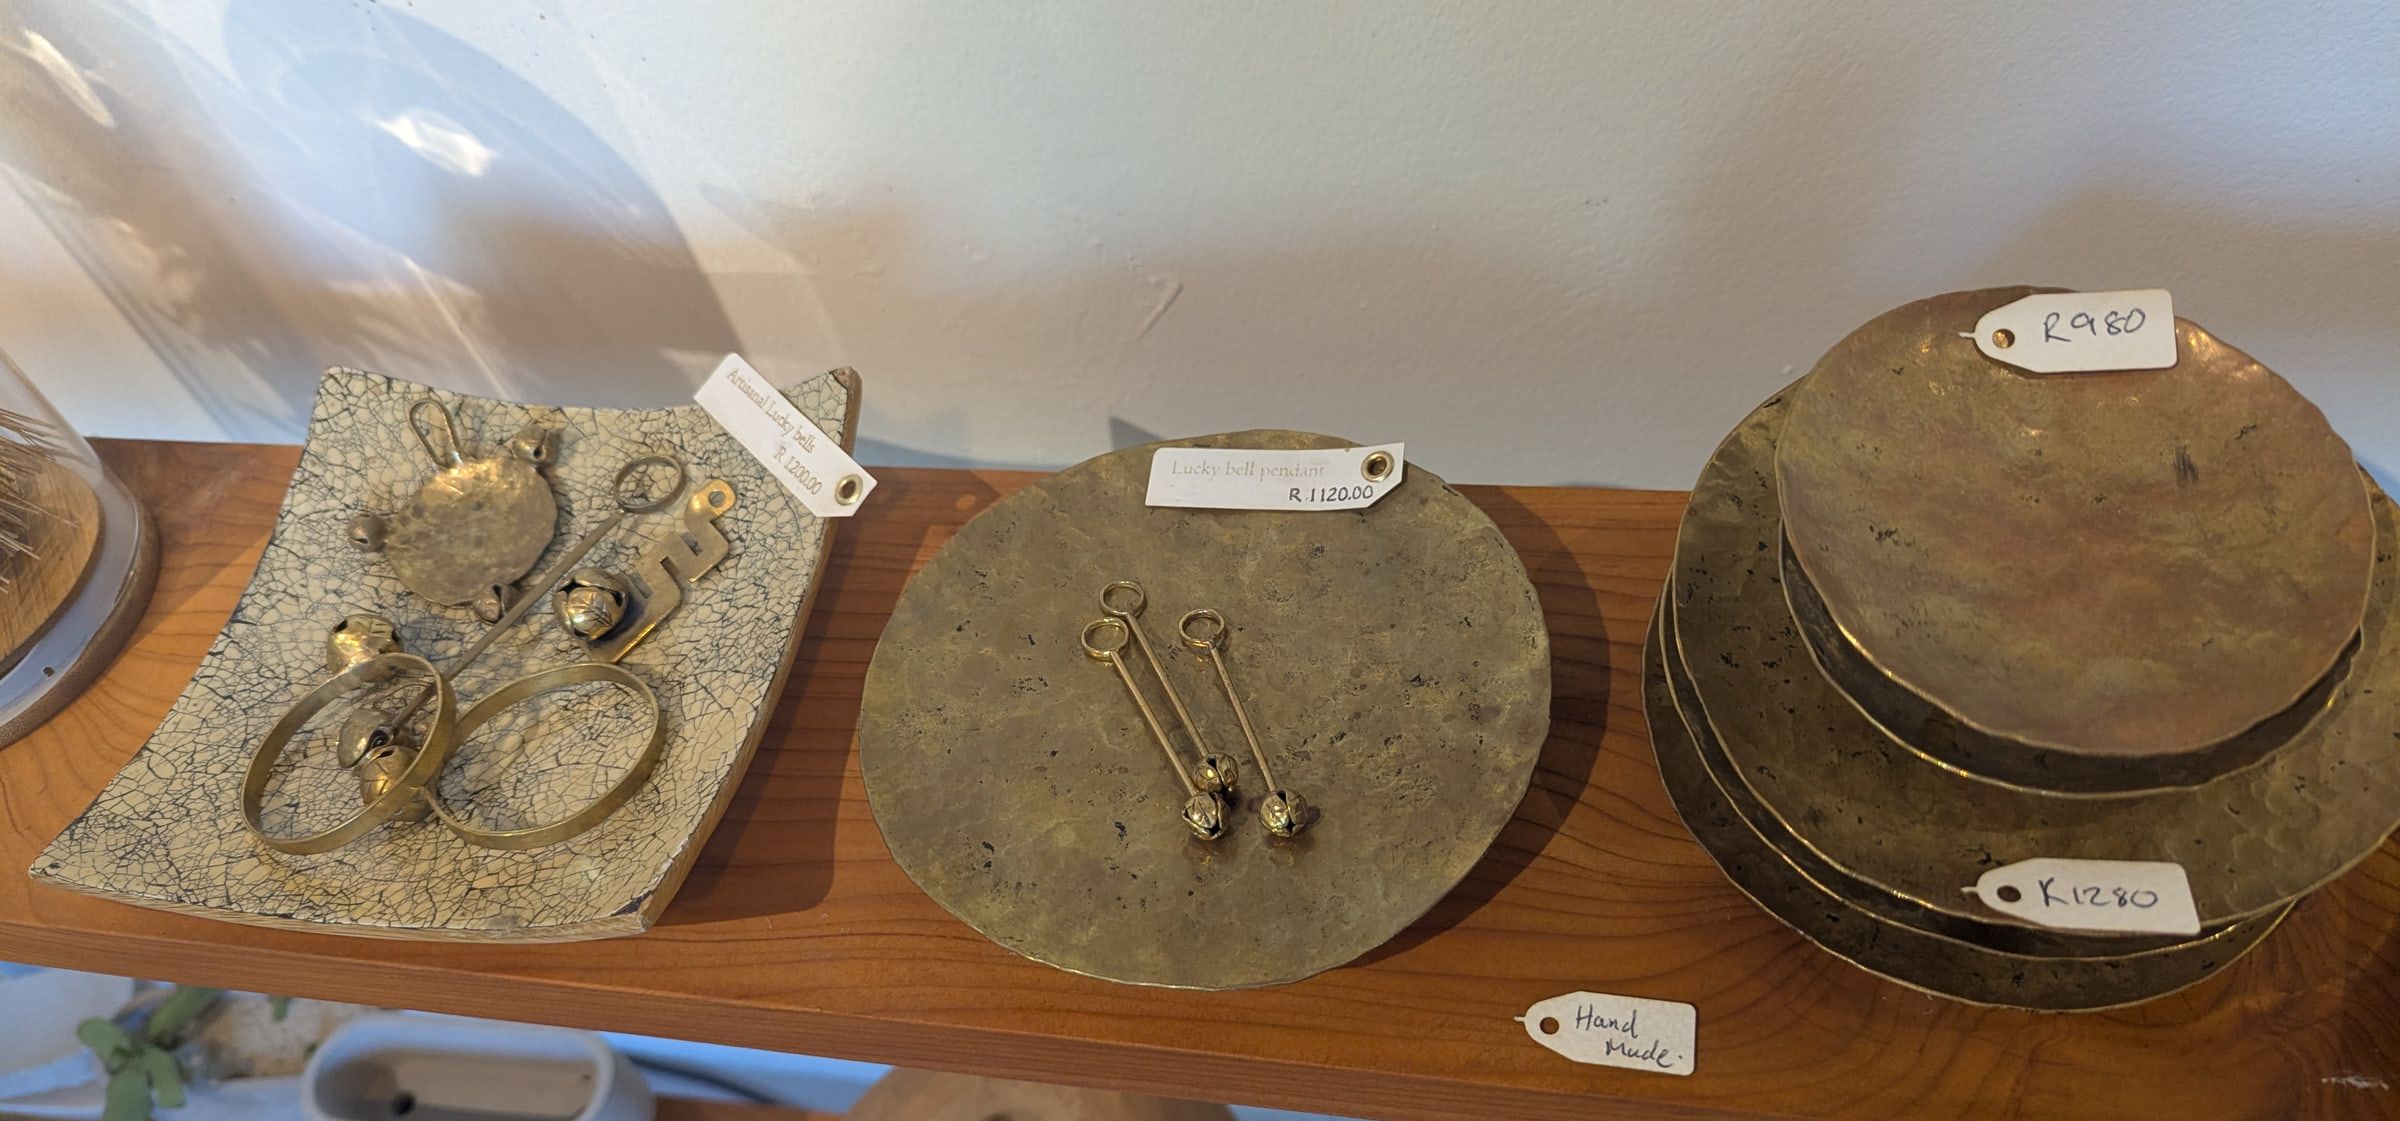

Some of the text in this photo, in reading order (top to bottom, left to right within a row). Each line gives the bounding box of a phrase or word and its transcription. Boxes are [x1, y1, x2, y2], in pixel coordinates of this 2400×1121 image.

[2043, 308, 2146, 343] R980
[727, 368, 816, 453] Artisanal Lucky bells
[773, 445, 786, 463] R
[1172, 460, 1326, 482] Lucky bell pendant
[1575, 1004, 1639, 1039] Hand
